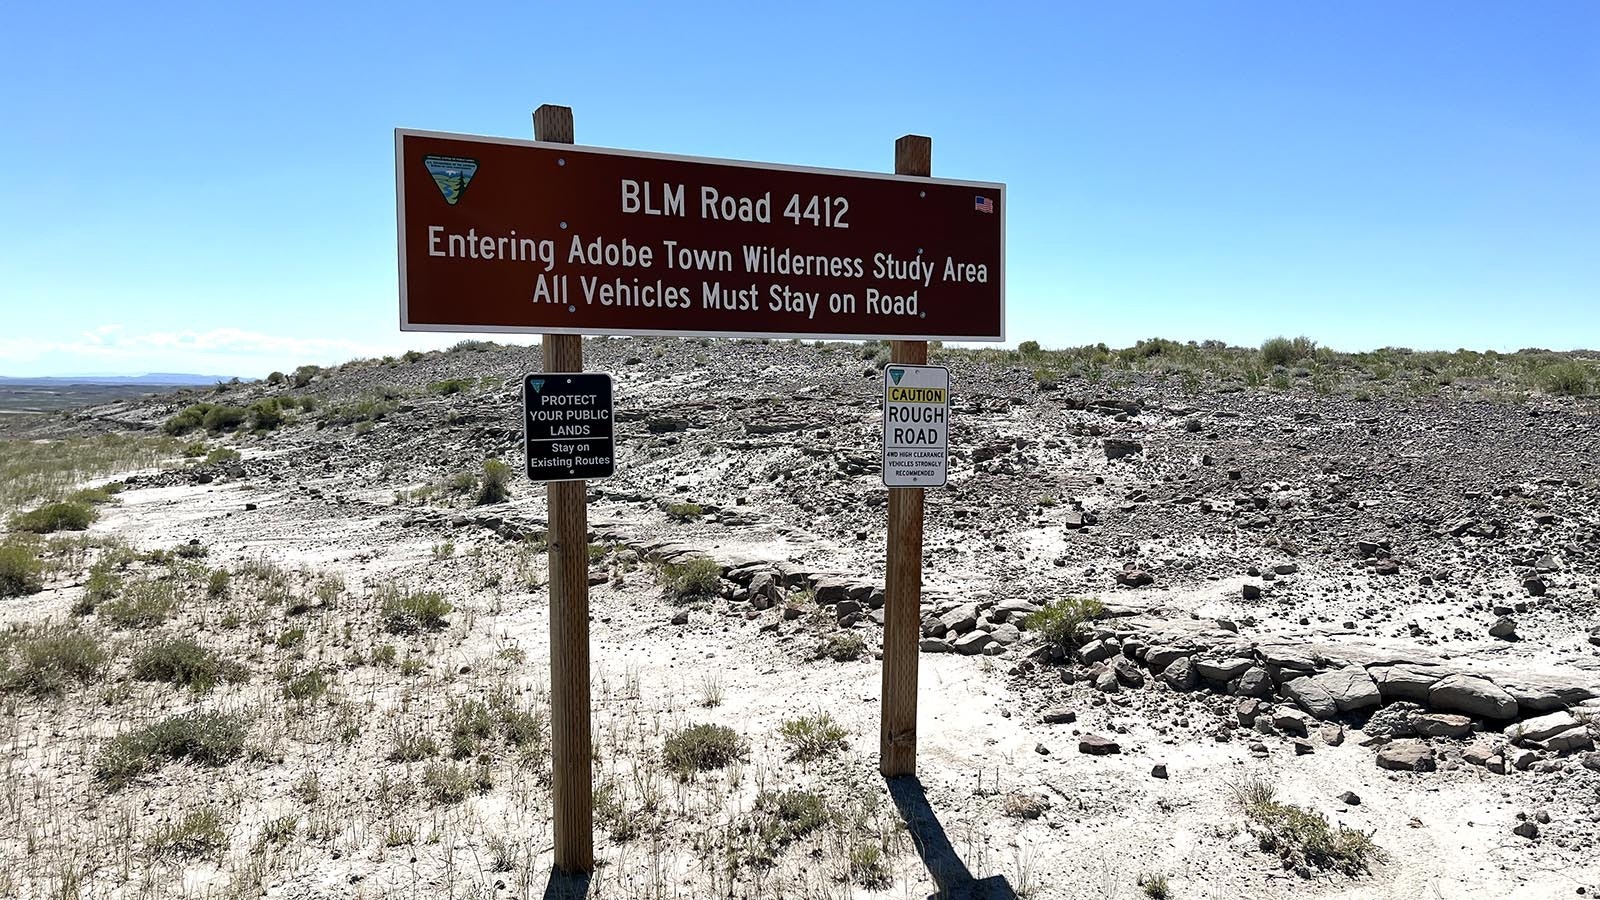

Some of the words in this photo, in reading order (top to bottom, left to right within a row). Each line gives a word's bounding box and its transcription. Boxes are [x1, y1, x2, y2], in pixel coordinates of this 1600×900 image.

[622, 179, 685, 217] BLM
[701, 186, 771, 223] Road
[783, 194, 849, 228] 4412
[428, 225, 554, 272] Entering
[568, 235, 653, 268] Adobe
[663, 240, 732, 272] Town
[743, 245, 864, 278] Wilderness
[873, 252, 934, 287] Study
[943, 256, 988, 283] Area
[533, 274, 568, 304] All
[580, 276, 691, 309] Vehicles
[703, 282, 759, 311] Must
[769, 284, 819, 319] Stay
[829, 292, 855, 314] on
[866, 288, 918, 316] Road
[541, 395, 597, 406] PROTECT
[892, 389, 942, 401] CAUTION
[530, 410, 563, 421] YOUR
[566, 410, 609, 420] PUBLIC
[889, 406, 944, 423] ROUGH
[550, 425, 590, 436] LANDS
[894, 428, 938, 444] ROAD
[552, 443, 574, 454] Stay
[531, 457, 572, 468] Existing
[575, 456, 610, 465] Routes
